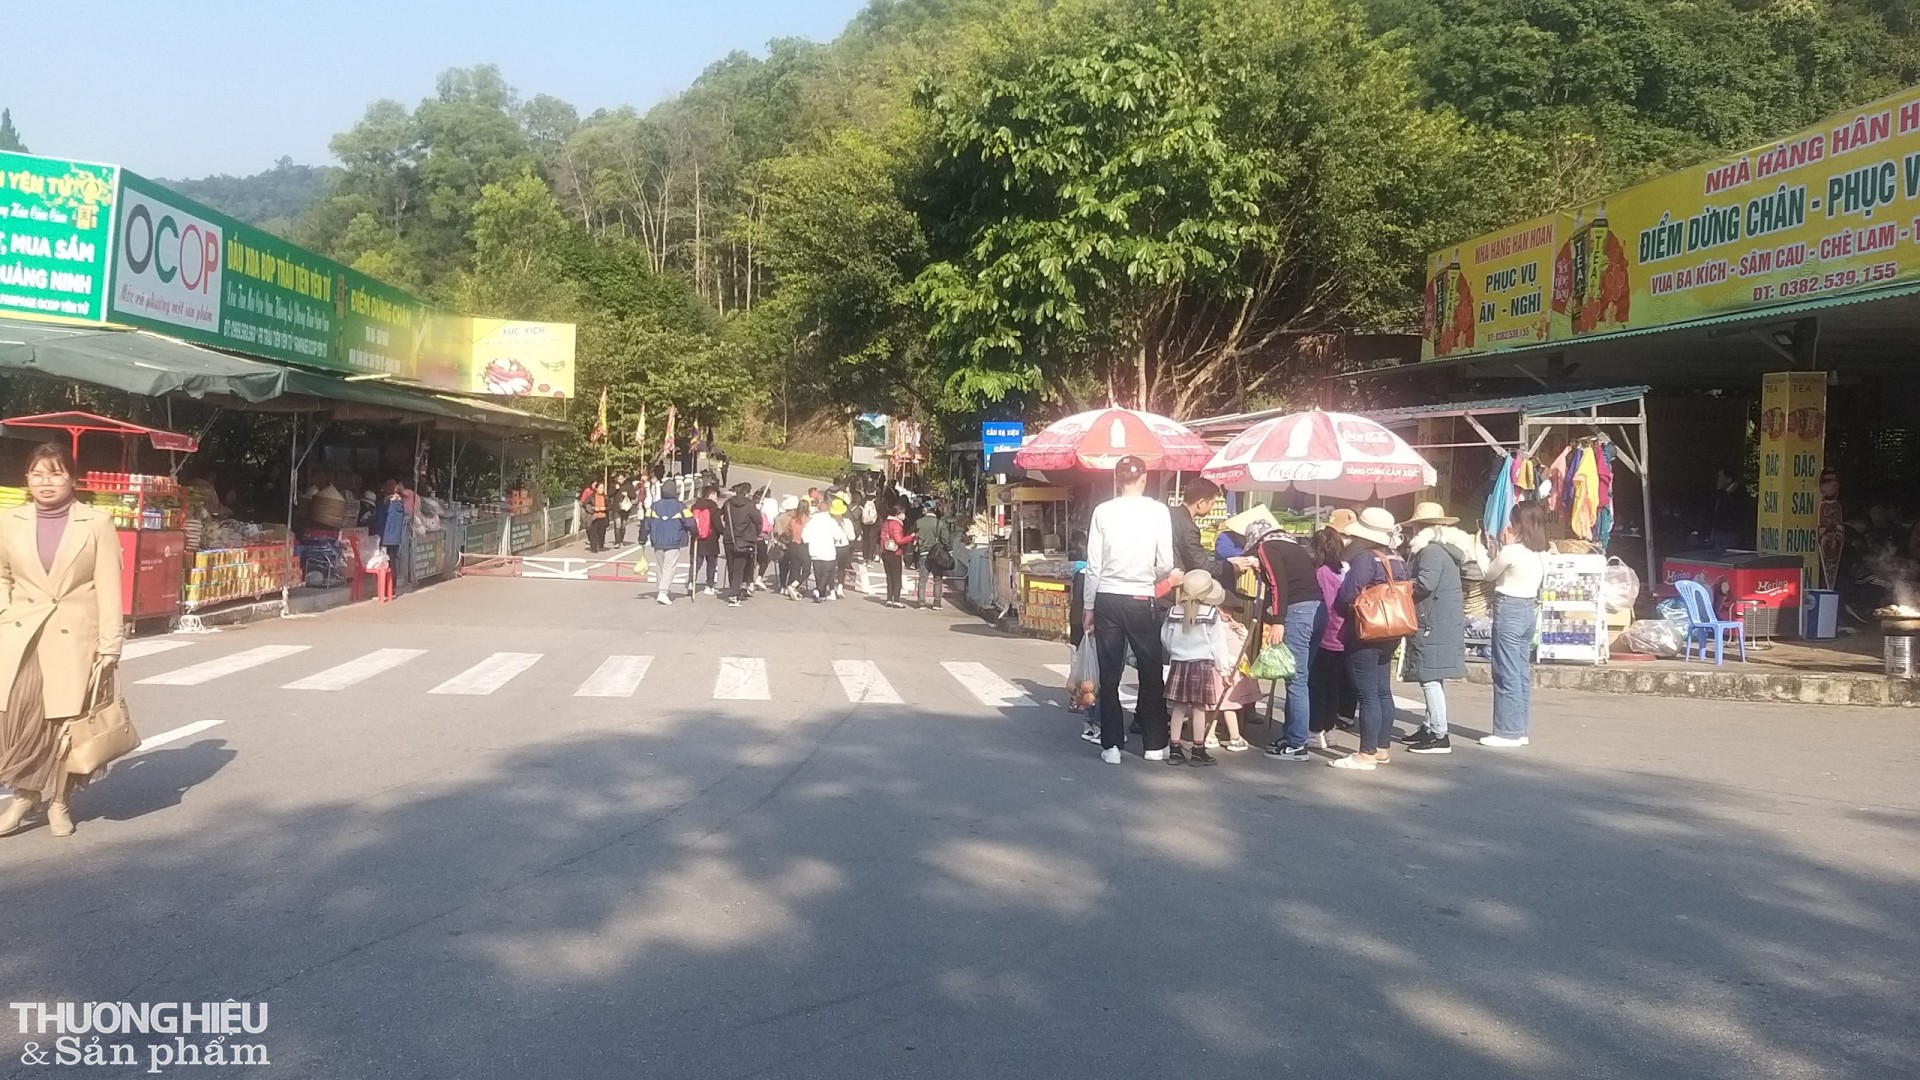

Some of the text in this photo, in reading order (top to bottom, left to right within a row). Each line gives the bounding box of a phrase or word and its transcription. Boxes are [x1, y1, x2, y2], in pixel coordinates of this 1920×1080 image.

[1705, 157, 1750, 194] NHÀ
[1757, 143, 1825, 177] HÀNG
[1831, 116, 1891, 154] HÂN
[8, 170, 44, 195] YÊN
[1639, 213, 1683, 264] ĐIỂM
[1687, 206, 1740, 251] DỪNG
[1746, 185, 1805, 236] CHÂN
[1827, 161, 1896, 217] PHỤC
[10, 233, 52, 258] MUA
[125, 203, 219, 295] OCOP
[1651, 275, 1673, 295] VUA
[1676, 269, 1692, 290] BA
[1696, 261, 1726, 285] KÍCH
[1739, 251, 1771, 276] SÂM
[1775, 244, 1805, 267] CAU
[1820, 229, 1852, 260] CHÈ
[1857, 224, 1895, 252] LAM
[50, 270, 92, 295] NINH
[1486, 268, 1517, 293] PHỤC
[1521, 262, 1537, 286] VỤ
[1779, 262, 1897, 297] 0382.539.155
[1479, 302, 1495, 323] ĂN
[1511, 285, 1542, 317] NGHỈ
[1792, 384, 1812, 393] TEA
[1793, 450, 1816, 482] ĐẶC
[1791, 484, 1815, 515] SẢN
[1786, 524, 1816, 552] RỪNG
[1758, 579, 1789, 591] Merino
